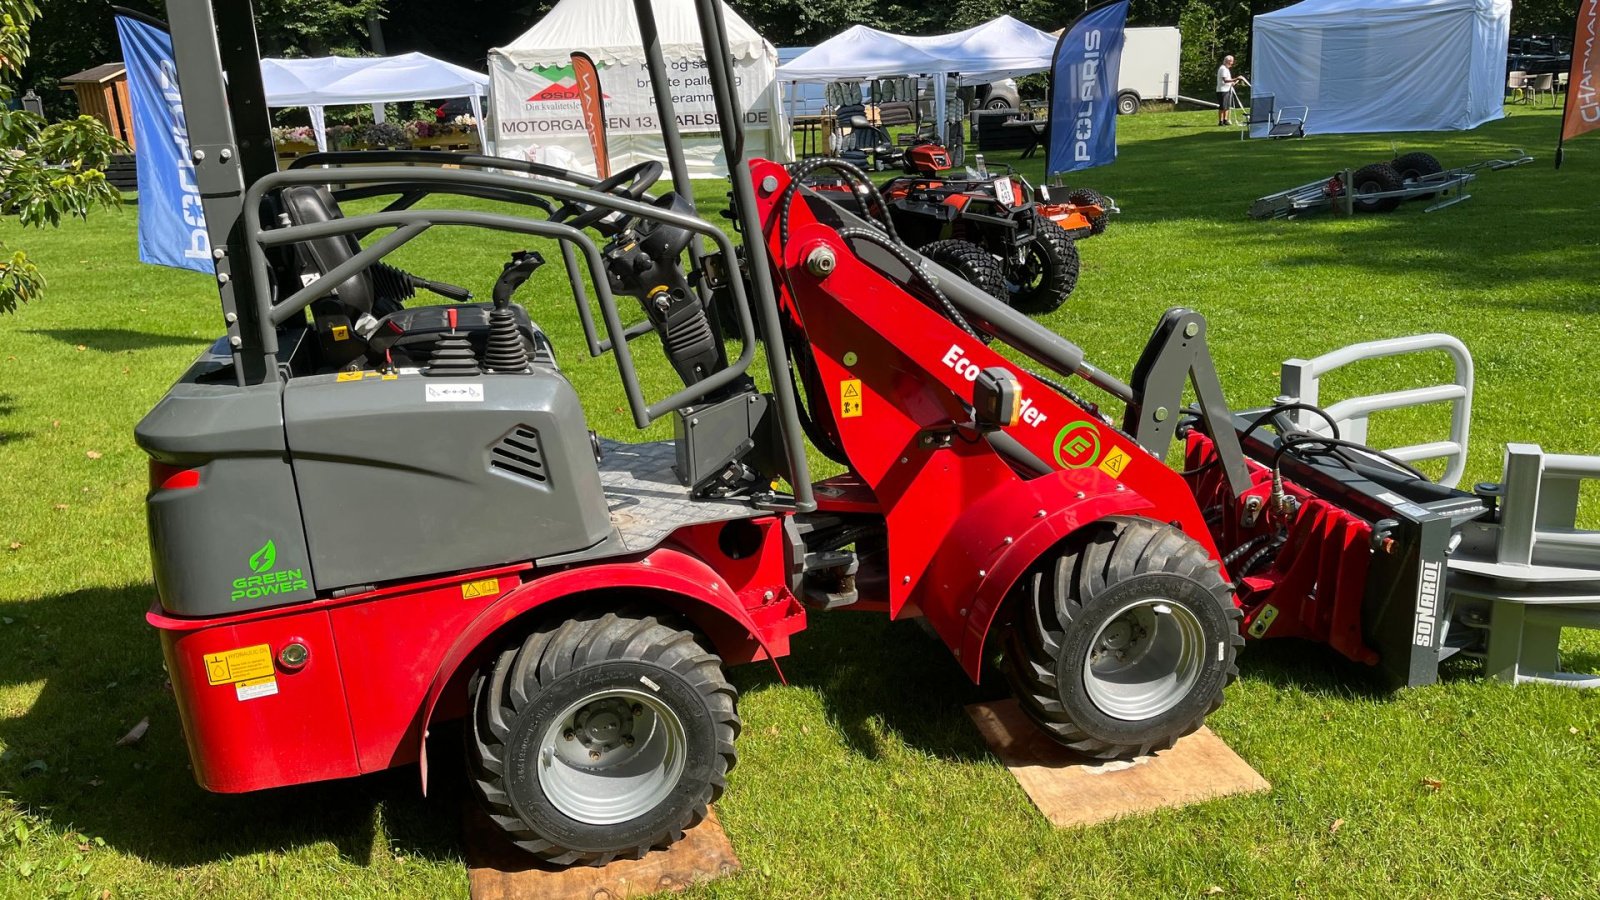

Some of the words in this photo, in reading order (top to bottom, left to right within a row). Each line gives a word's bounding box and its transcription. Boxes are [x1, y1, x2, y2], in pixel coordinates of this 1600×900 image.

[637, 77, 680, 88] brte
[1075, 29, 1101, 162] POLARIS
[502, 117, 630, 133] MOTORGAEN
[636, 116, 657, 128] 13,
[232, 568, 303, 589] GREEN
[231, 579, 308, 602] POWER
[1416, 560, 1439, 647] SONAROL
